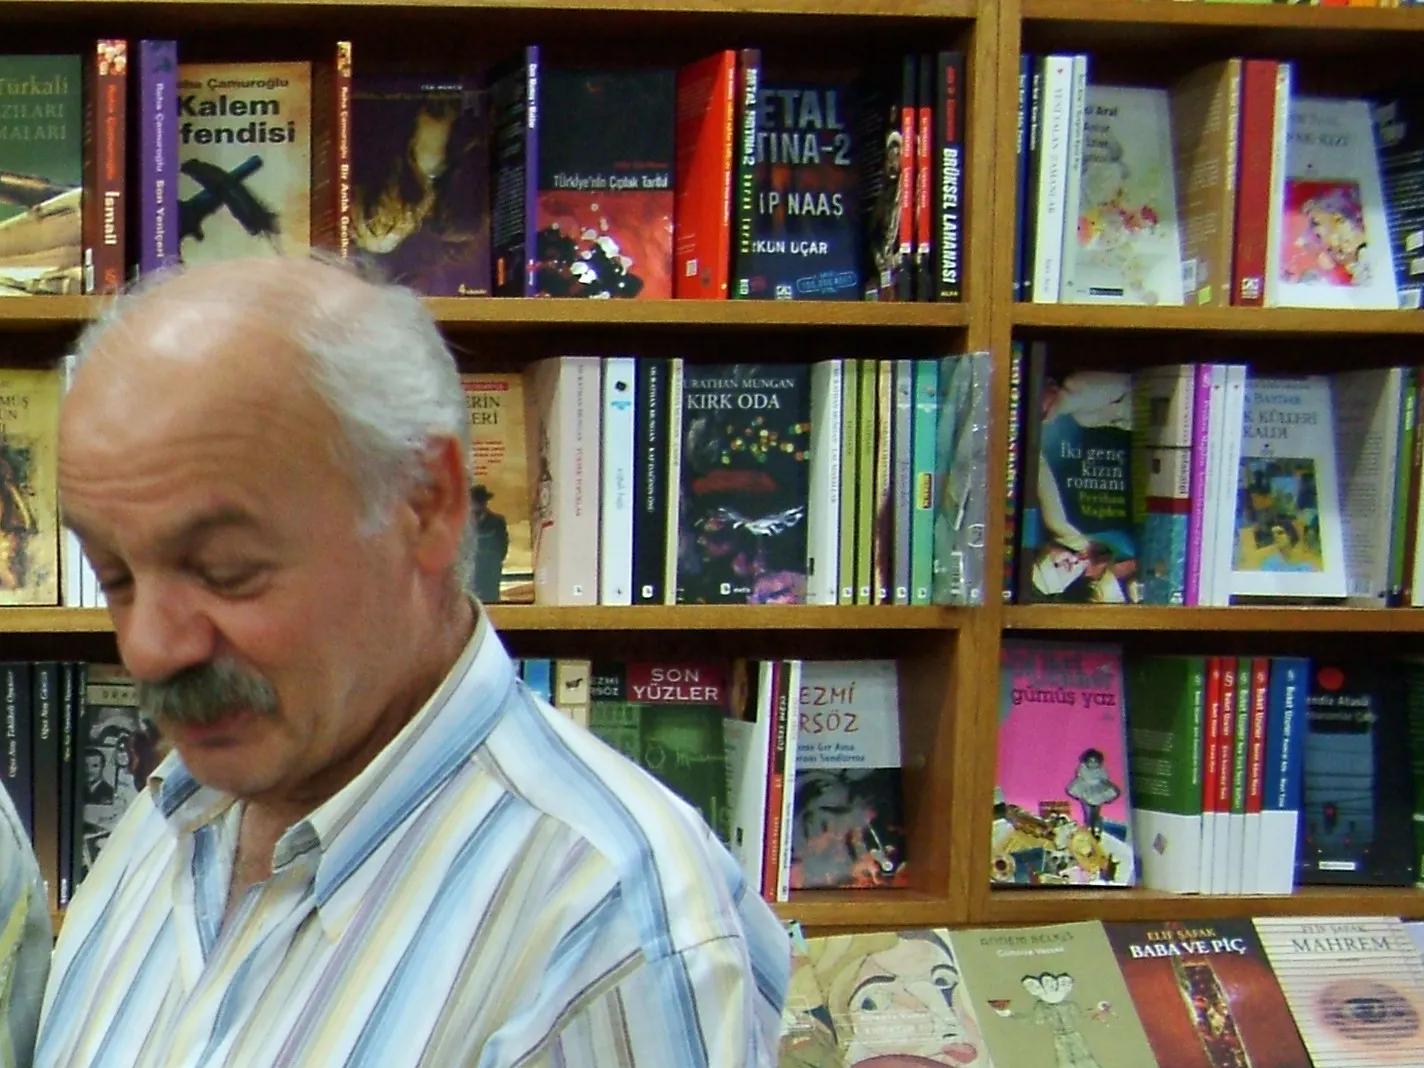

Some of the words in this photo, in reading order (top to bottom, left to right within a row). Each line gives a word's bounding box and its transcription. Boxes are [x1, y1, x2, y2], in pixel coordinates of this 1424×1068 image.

[207, 77, 289, 91] Çamuroğlu
[177, 94, 281, 117] Kalem
[756, 88, 846, 130] ETAL
[180, 120, 297, 144] fendisi
[754, 131, 852, 166] TINA-2
[942, 148, 960, 210] BRÜKSEL
[787, 192, 844, 219] NAAŞ
[104, 191, 120, 245] İsmail
[154, 207, 165, 258] Yeniçeri
[790, 241, 829, 257] UÇAR
[941, 214, 958, 283] LAHANASI
[682, 379, 738, 390] URATHAN
[741, 378, 795, 390] MUNGAN
[687, 392, 733, 410] KIRK
[737, 392, 781, 410] ODA
[1060, 441, 1084, 459] İki
[1086, 446, 1126, 464] genç
[1066, 475, 1126, 491] romanı
[650, 667, 700, 683] SON
[633, 681, 719, 701] YÜZLER
[799, 681, 856, 706] EZMİ
[1011, 686, 1075, 707] gümüş
[1082, 690, 1116, 708] yaz
[1238, 689, 1248, 711] Buket
[1255, 688, 1266, 710] Buket
[1284, 686, 1295, 708] Buket
[799, 710, 859, 733] RSÖZ
[1237, 713, 1247, 739] Uzuner
[1254, 712, 1264, 738] Uzuner
[1283, 711, 1293, 737] Uzuner
[1146, 928, 1174, 941] ELİF
[1176, 926, 1215, 941] ŞAFAK
[1291, 936, 1394, 953] MAHREM
[1129, 939, 1178, 959] BABA
[1182, 938, 1210, 957] VE
[1212, 935, 1247, 956] PİÇ
